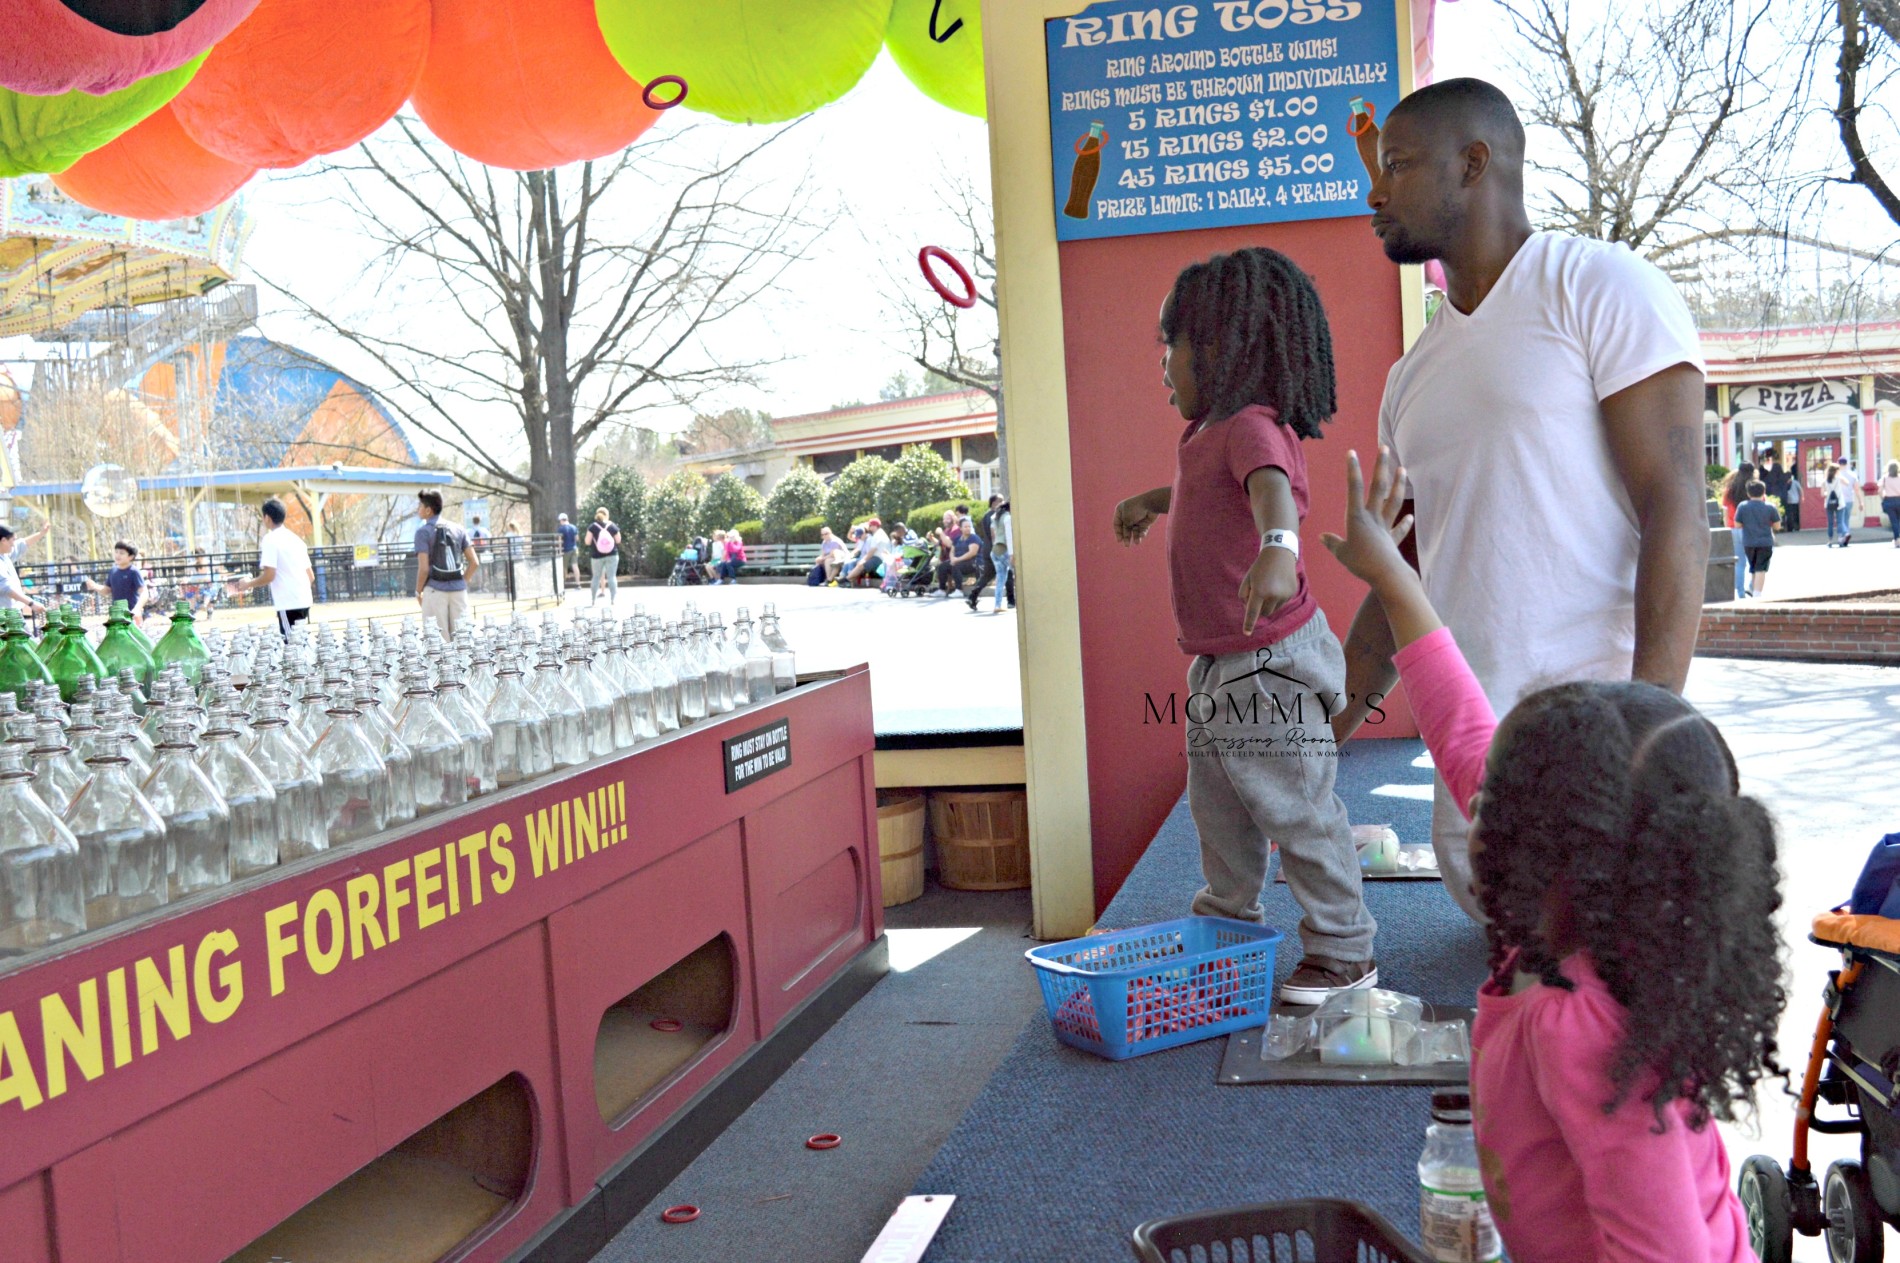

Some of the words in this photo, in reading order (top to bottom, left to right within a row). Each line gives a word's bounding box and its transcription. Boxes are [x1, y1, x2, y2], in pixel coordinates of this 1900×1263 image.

[1062, 5, 1199, 48] RING
[1213, 0, 1363, 32] TOSS
[1106, 56, 1146, 78] RING
[1150, 50, 1216, 74] AROUND
[1219, 42, 1284, 67] BOTTLE
[1288, 37, 1338, 61] WINS!
[1062, 88, 1111, 112] RINGS
[1115, 84, 1162, 107] MUST
[1165, 81, 1187, 101] BE
[1190, 74, 1264, 99] THROWN
[1268, 62, 1388, 92] INDIVIDUALLY
[1128, 109, 1146, 131] 5
[1154, 102, 1240, 129] RINGS
[1249, 95, 1318, 122] $1.00
[1121, 137, 1150, 160] 15
[1158, 131, 1244, 157] RINGS
[1252, 124, 1328, 151] $2.00
[1118, 165, 1155, 189] 45
[1163, 159, 1250, 185] RINGS
[1258, 153, 1334, 180] $5.00
[1097, 197, 1147, 220] PRIZE
[1150, 193, 1203, 215] LIMIT:
[1207, 191, 1214, 210] 1
[1217, 187, 1272, 209] DAILY,
[1276, 184, 1288, 206] 4
[1291, 180, 1359, 204] YEARLY
[1758, 383, 1835, 411] PIZZA
[63, 584, 81, 592] EXIT
[735, 763, 745, 781] FOR
[265, 822, 516, 997] FORFEITS
[525, 780, 628, 879] WIN!!!
